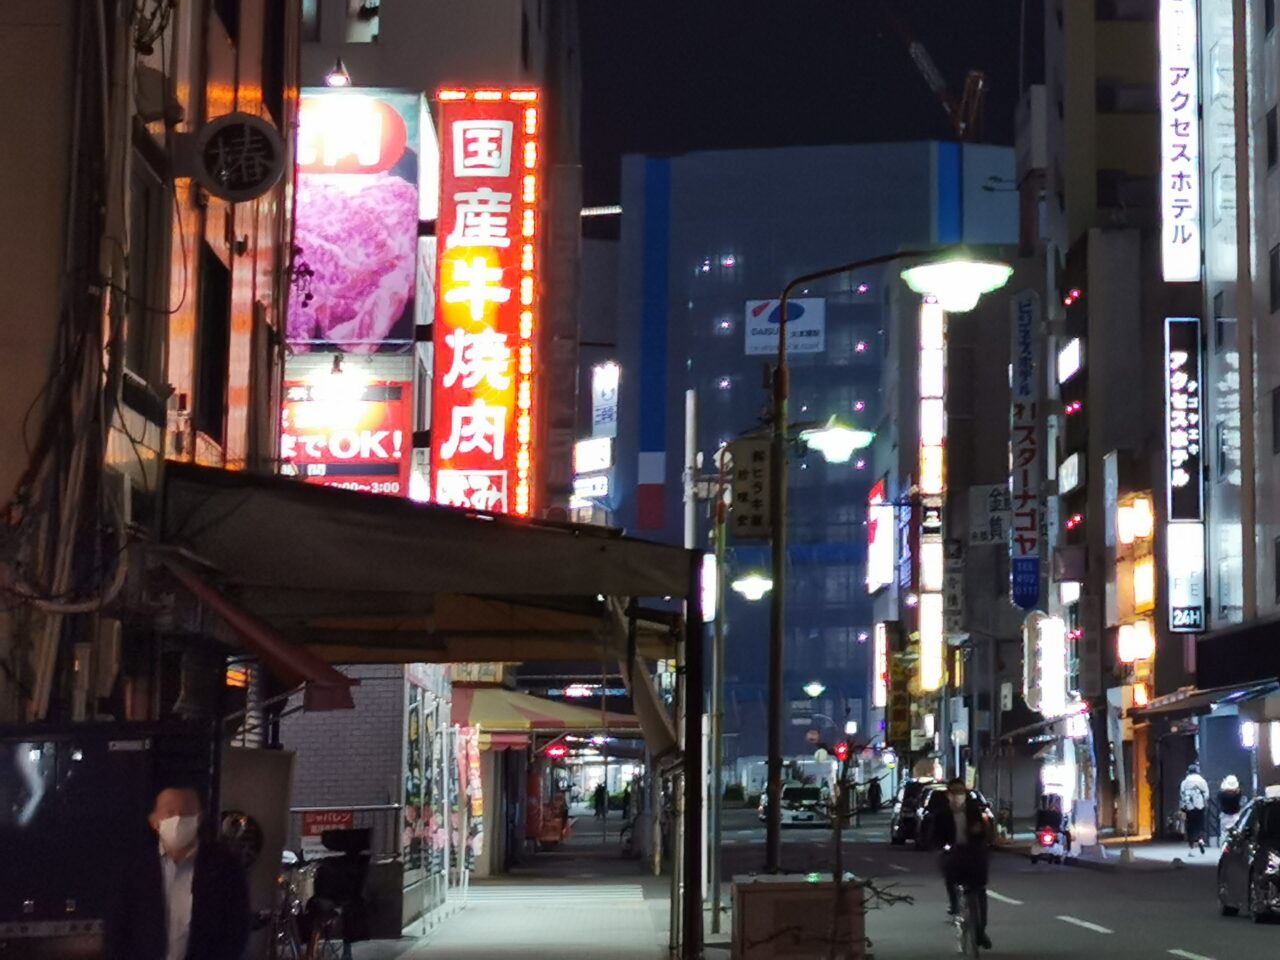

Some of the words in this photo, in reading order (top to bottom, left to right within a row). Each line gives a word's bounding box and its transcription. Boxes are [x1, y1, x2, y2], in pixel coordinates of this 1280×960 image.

[1169, 66, 1193, 244] アクセスホテル
[441, 119, 514, 460] 国産牛焼肉
[1173, 609, 1201, 627] 24H
